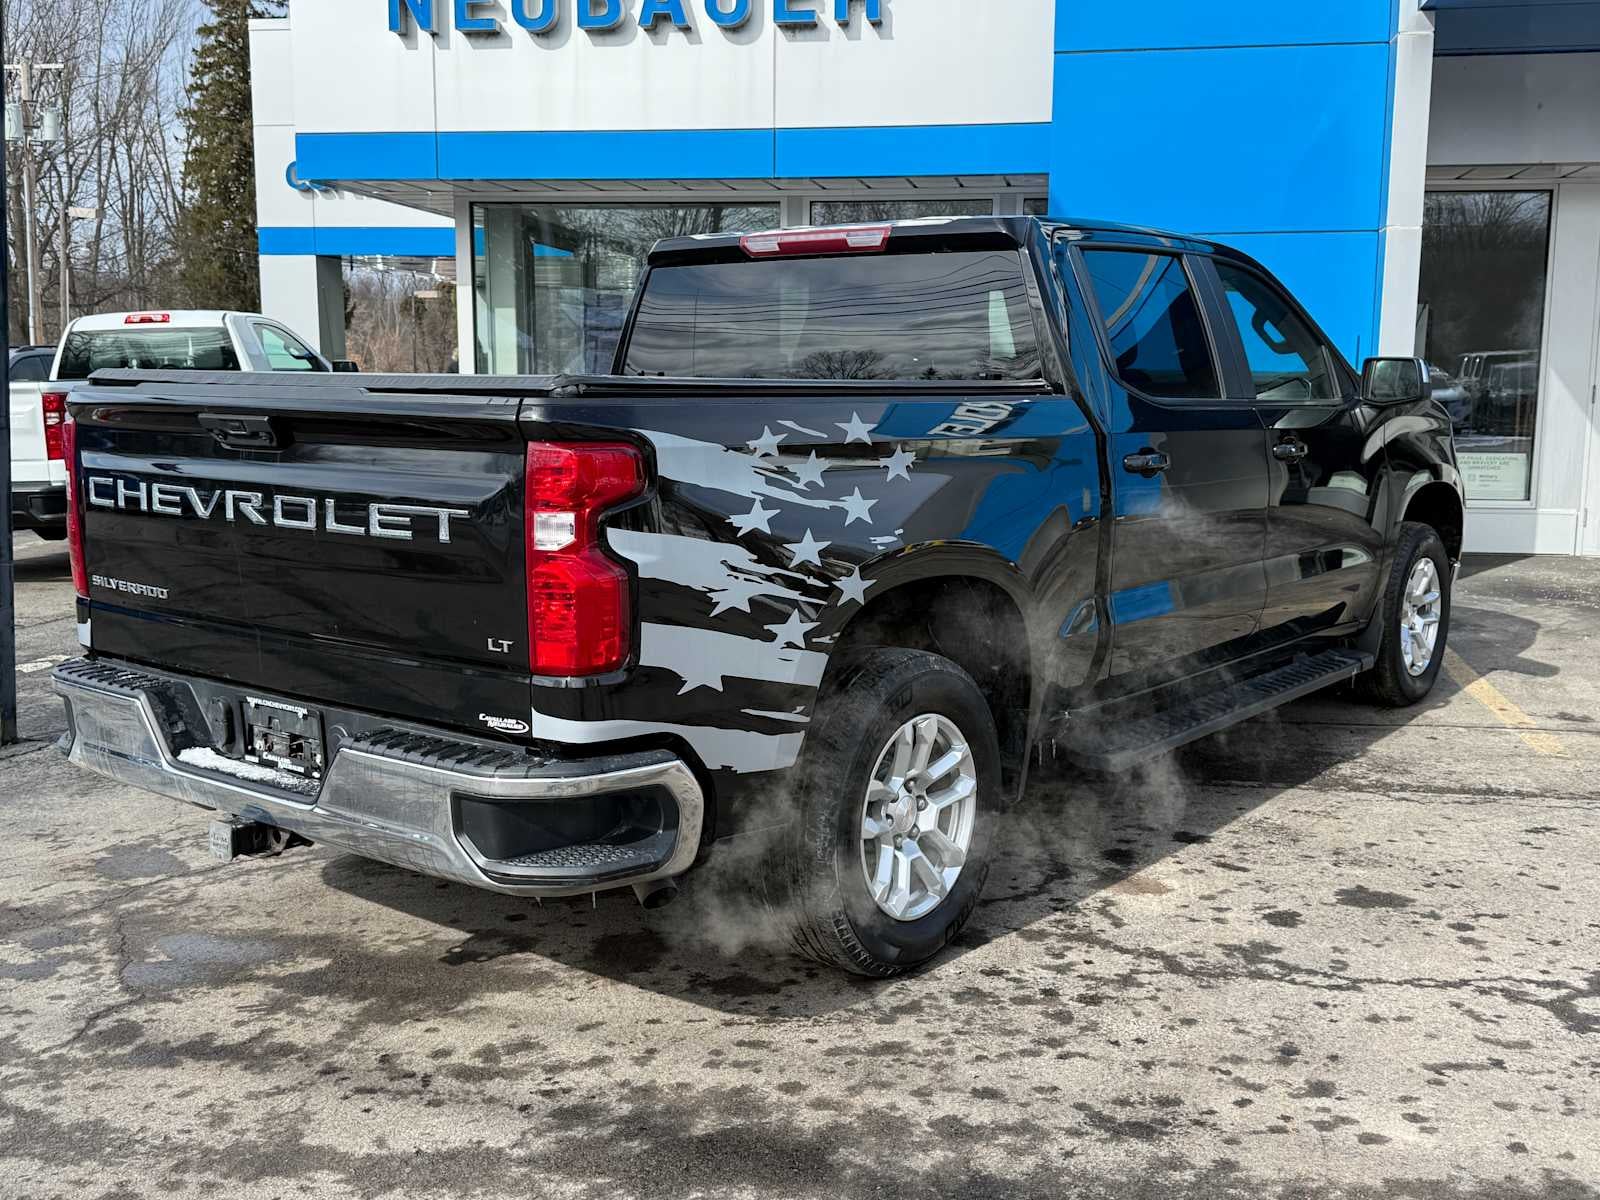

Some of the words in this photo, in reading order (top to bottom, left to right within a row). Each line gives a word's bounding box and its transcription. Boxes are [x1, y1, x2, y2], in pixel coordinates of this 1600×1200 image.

[89, 477, 471, 543] CHEVROLET
[92, 575, 169, 599] SILVERADO
[488, 638, 514, 653] LT
